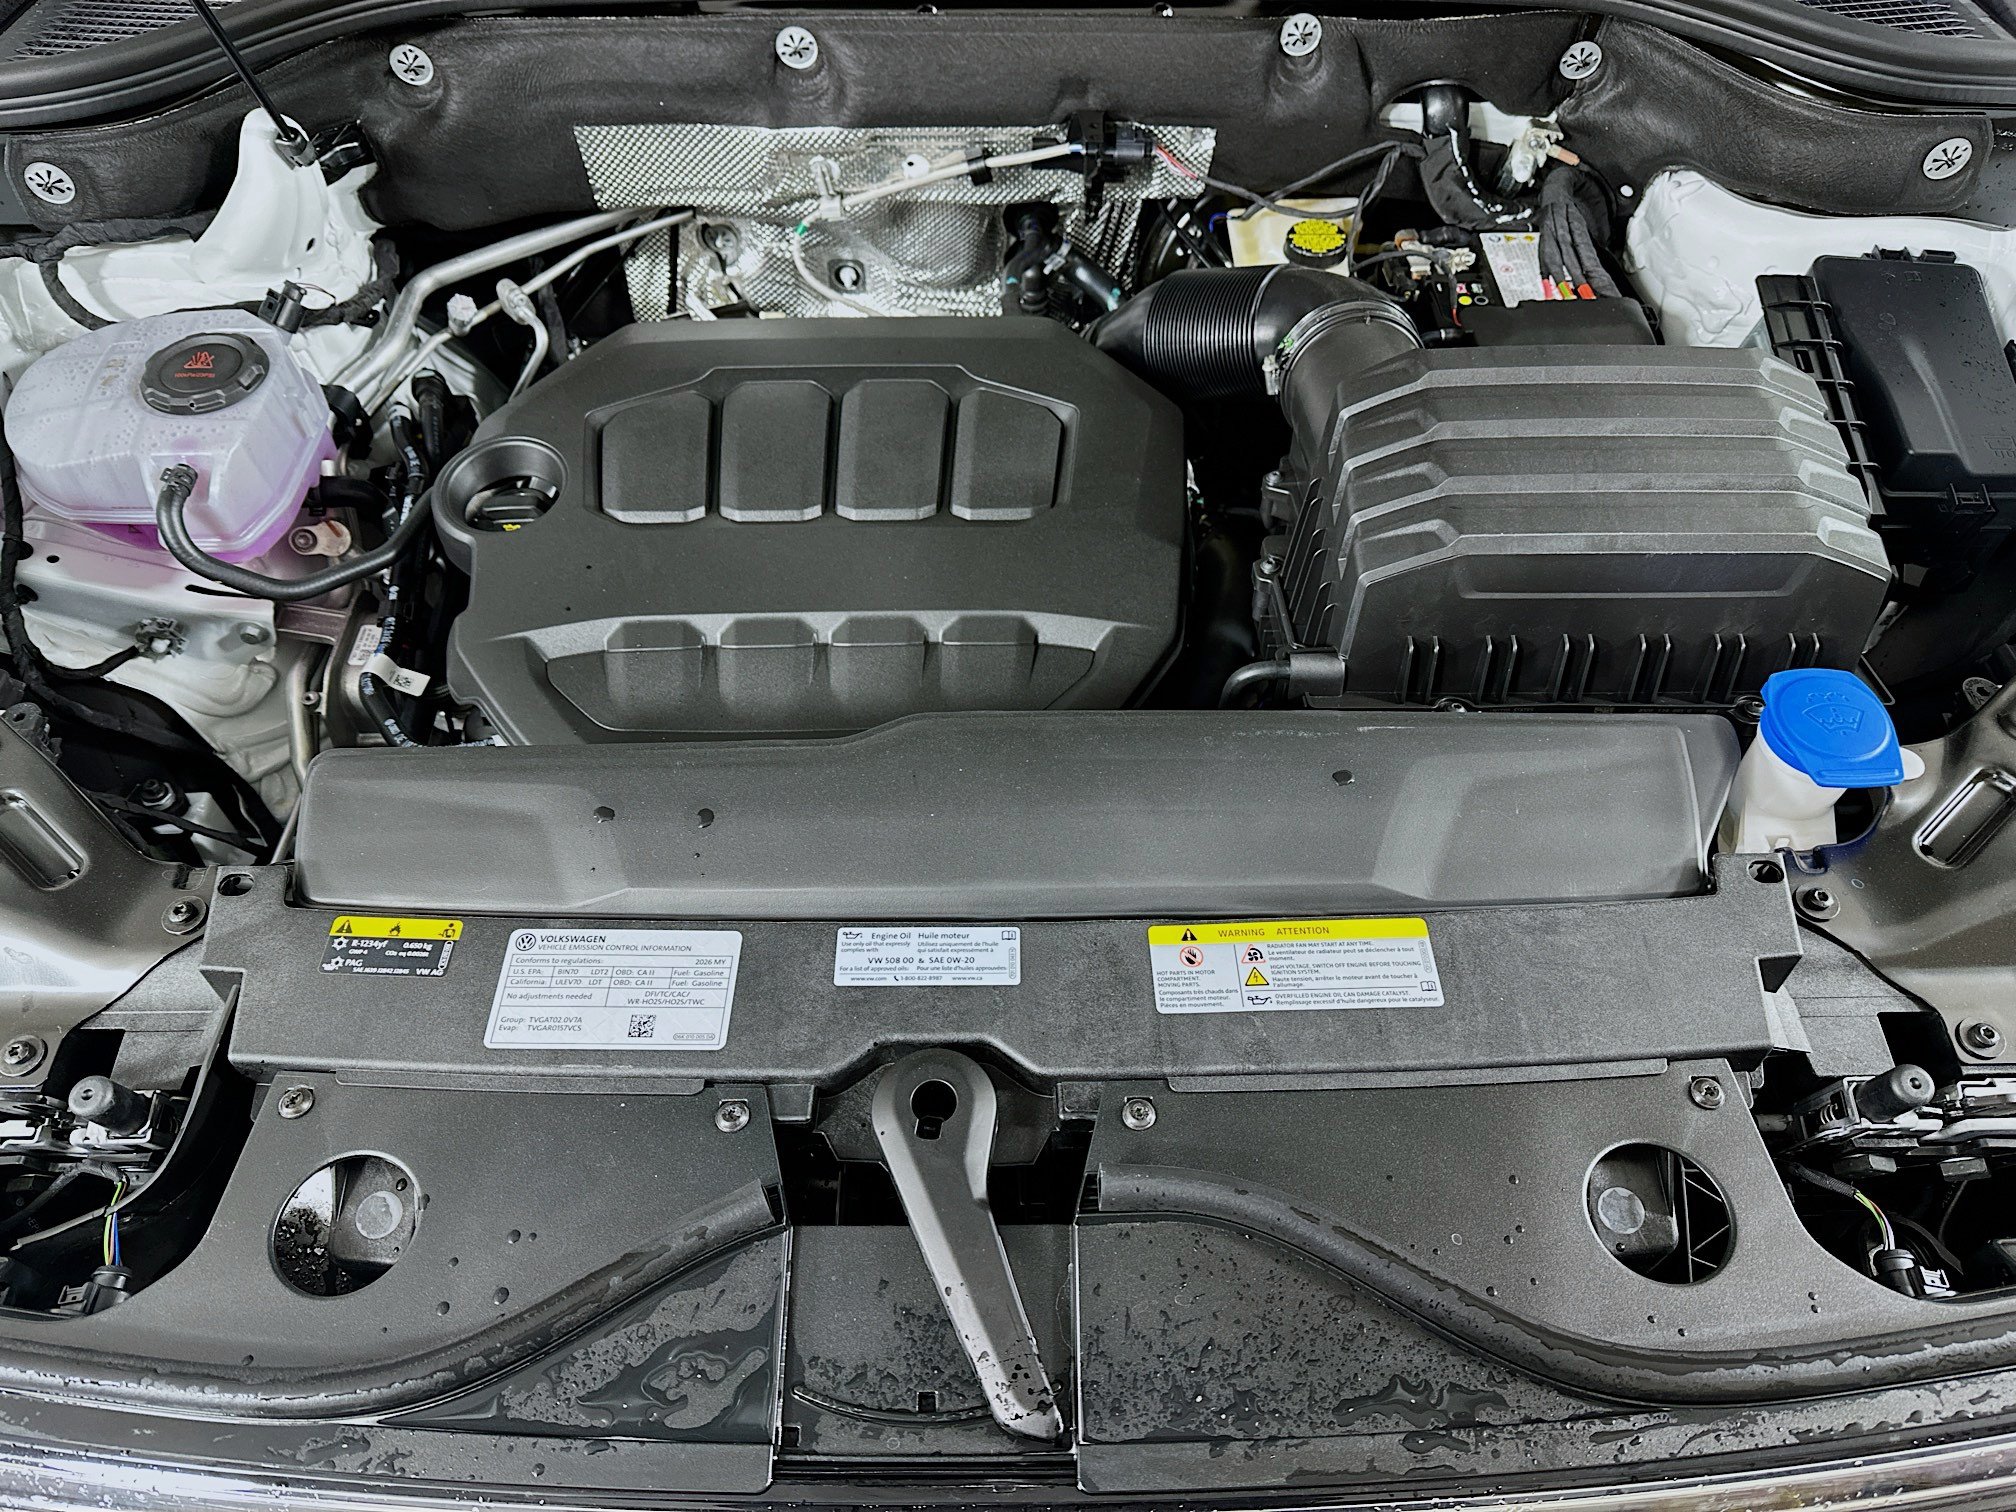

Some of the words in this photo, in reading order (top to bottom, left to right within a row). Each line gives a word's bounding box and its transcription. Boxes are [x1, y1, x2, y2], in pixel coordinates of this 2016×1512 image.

[1218, 928, 1265, 938] WARNING
[1276, 927, 1330, 935] ATTENTION
[540, 935, 607, 943] VOLKSWAGEN
[872, 933, 898, 941] Engine
[351, 940, 388, 950] R-1234yf
[423, 943, 433, 951] kg
[519, 992, 564, 1000] adjustments
[500, 1016, 526, 1024] Group:
